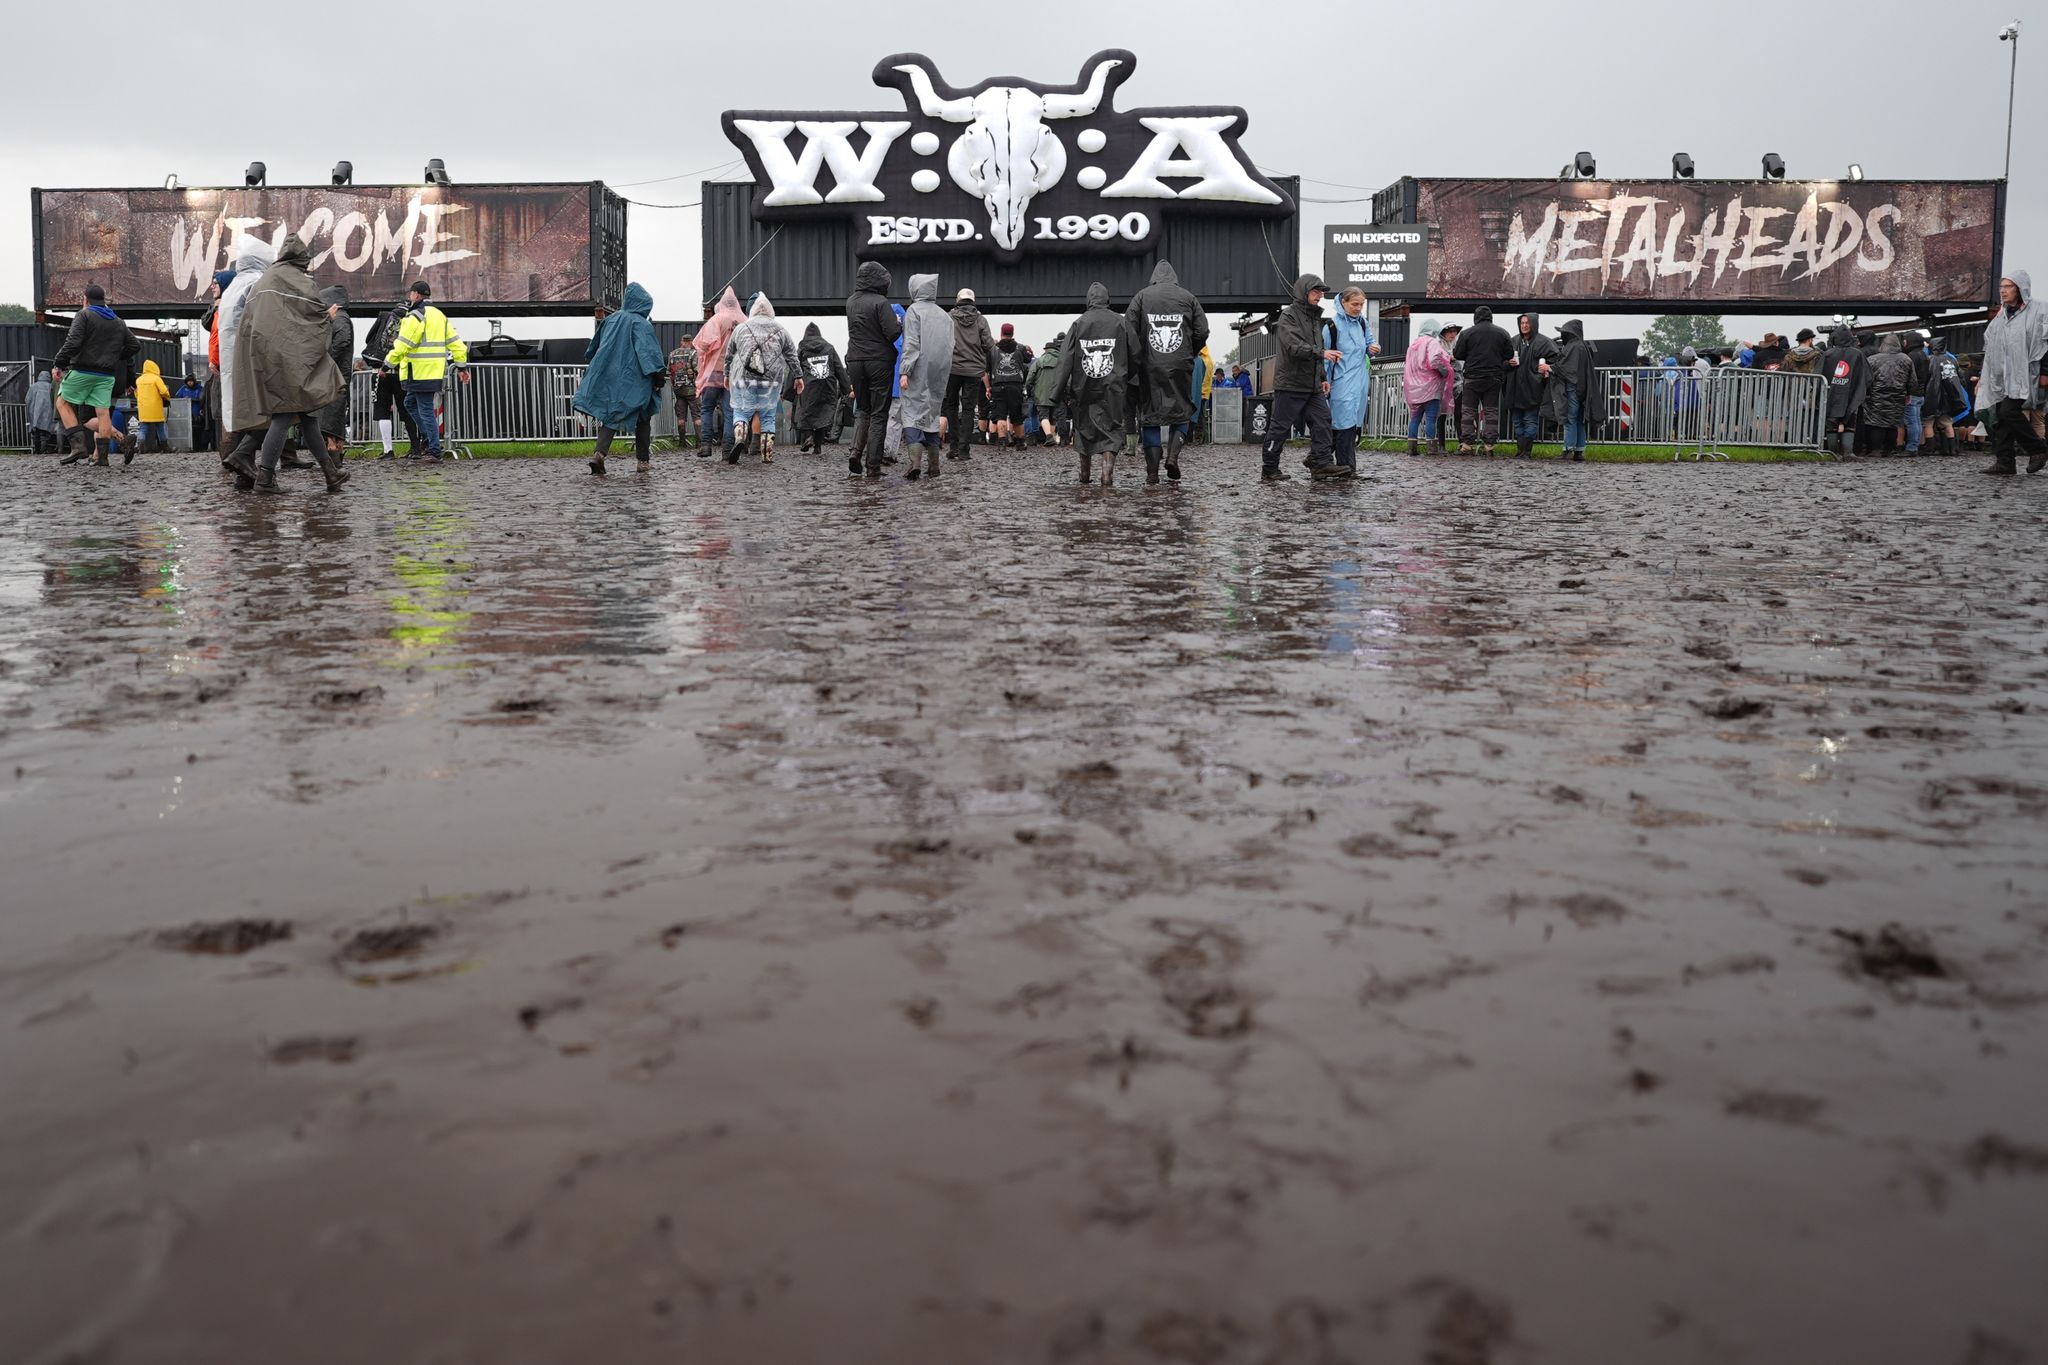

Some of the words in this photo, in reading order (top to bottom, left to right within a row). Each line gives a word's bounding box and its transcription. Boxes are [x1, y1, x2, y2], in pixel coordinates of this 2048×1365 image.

[866, 215, 983, 245] ESTD.
[1033, 211, 1150, 241] 1990
[1333, 233, 1361, 243] RAIN
[1362, 233, 1421, 243] EXPECTED
[1503, 189, 1901, 296] METALHEADS
[1347, 253, 1381, 262] SECURE
[1382, 253, 1406, 262] YOUR
[1353, 263, 1380, 272] TENTS
[1381, 263, 1400, 272] AND
[1348, 273, 1404, 282] BELONGINGS
[1147, 313, 1184, 323] WACKEN
[1079, 338, 1116, 348] WACKEN
